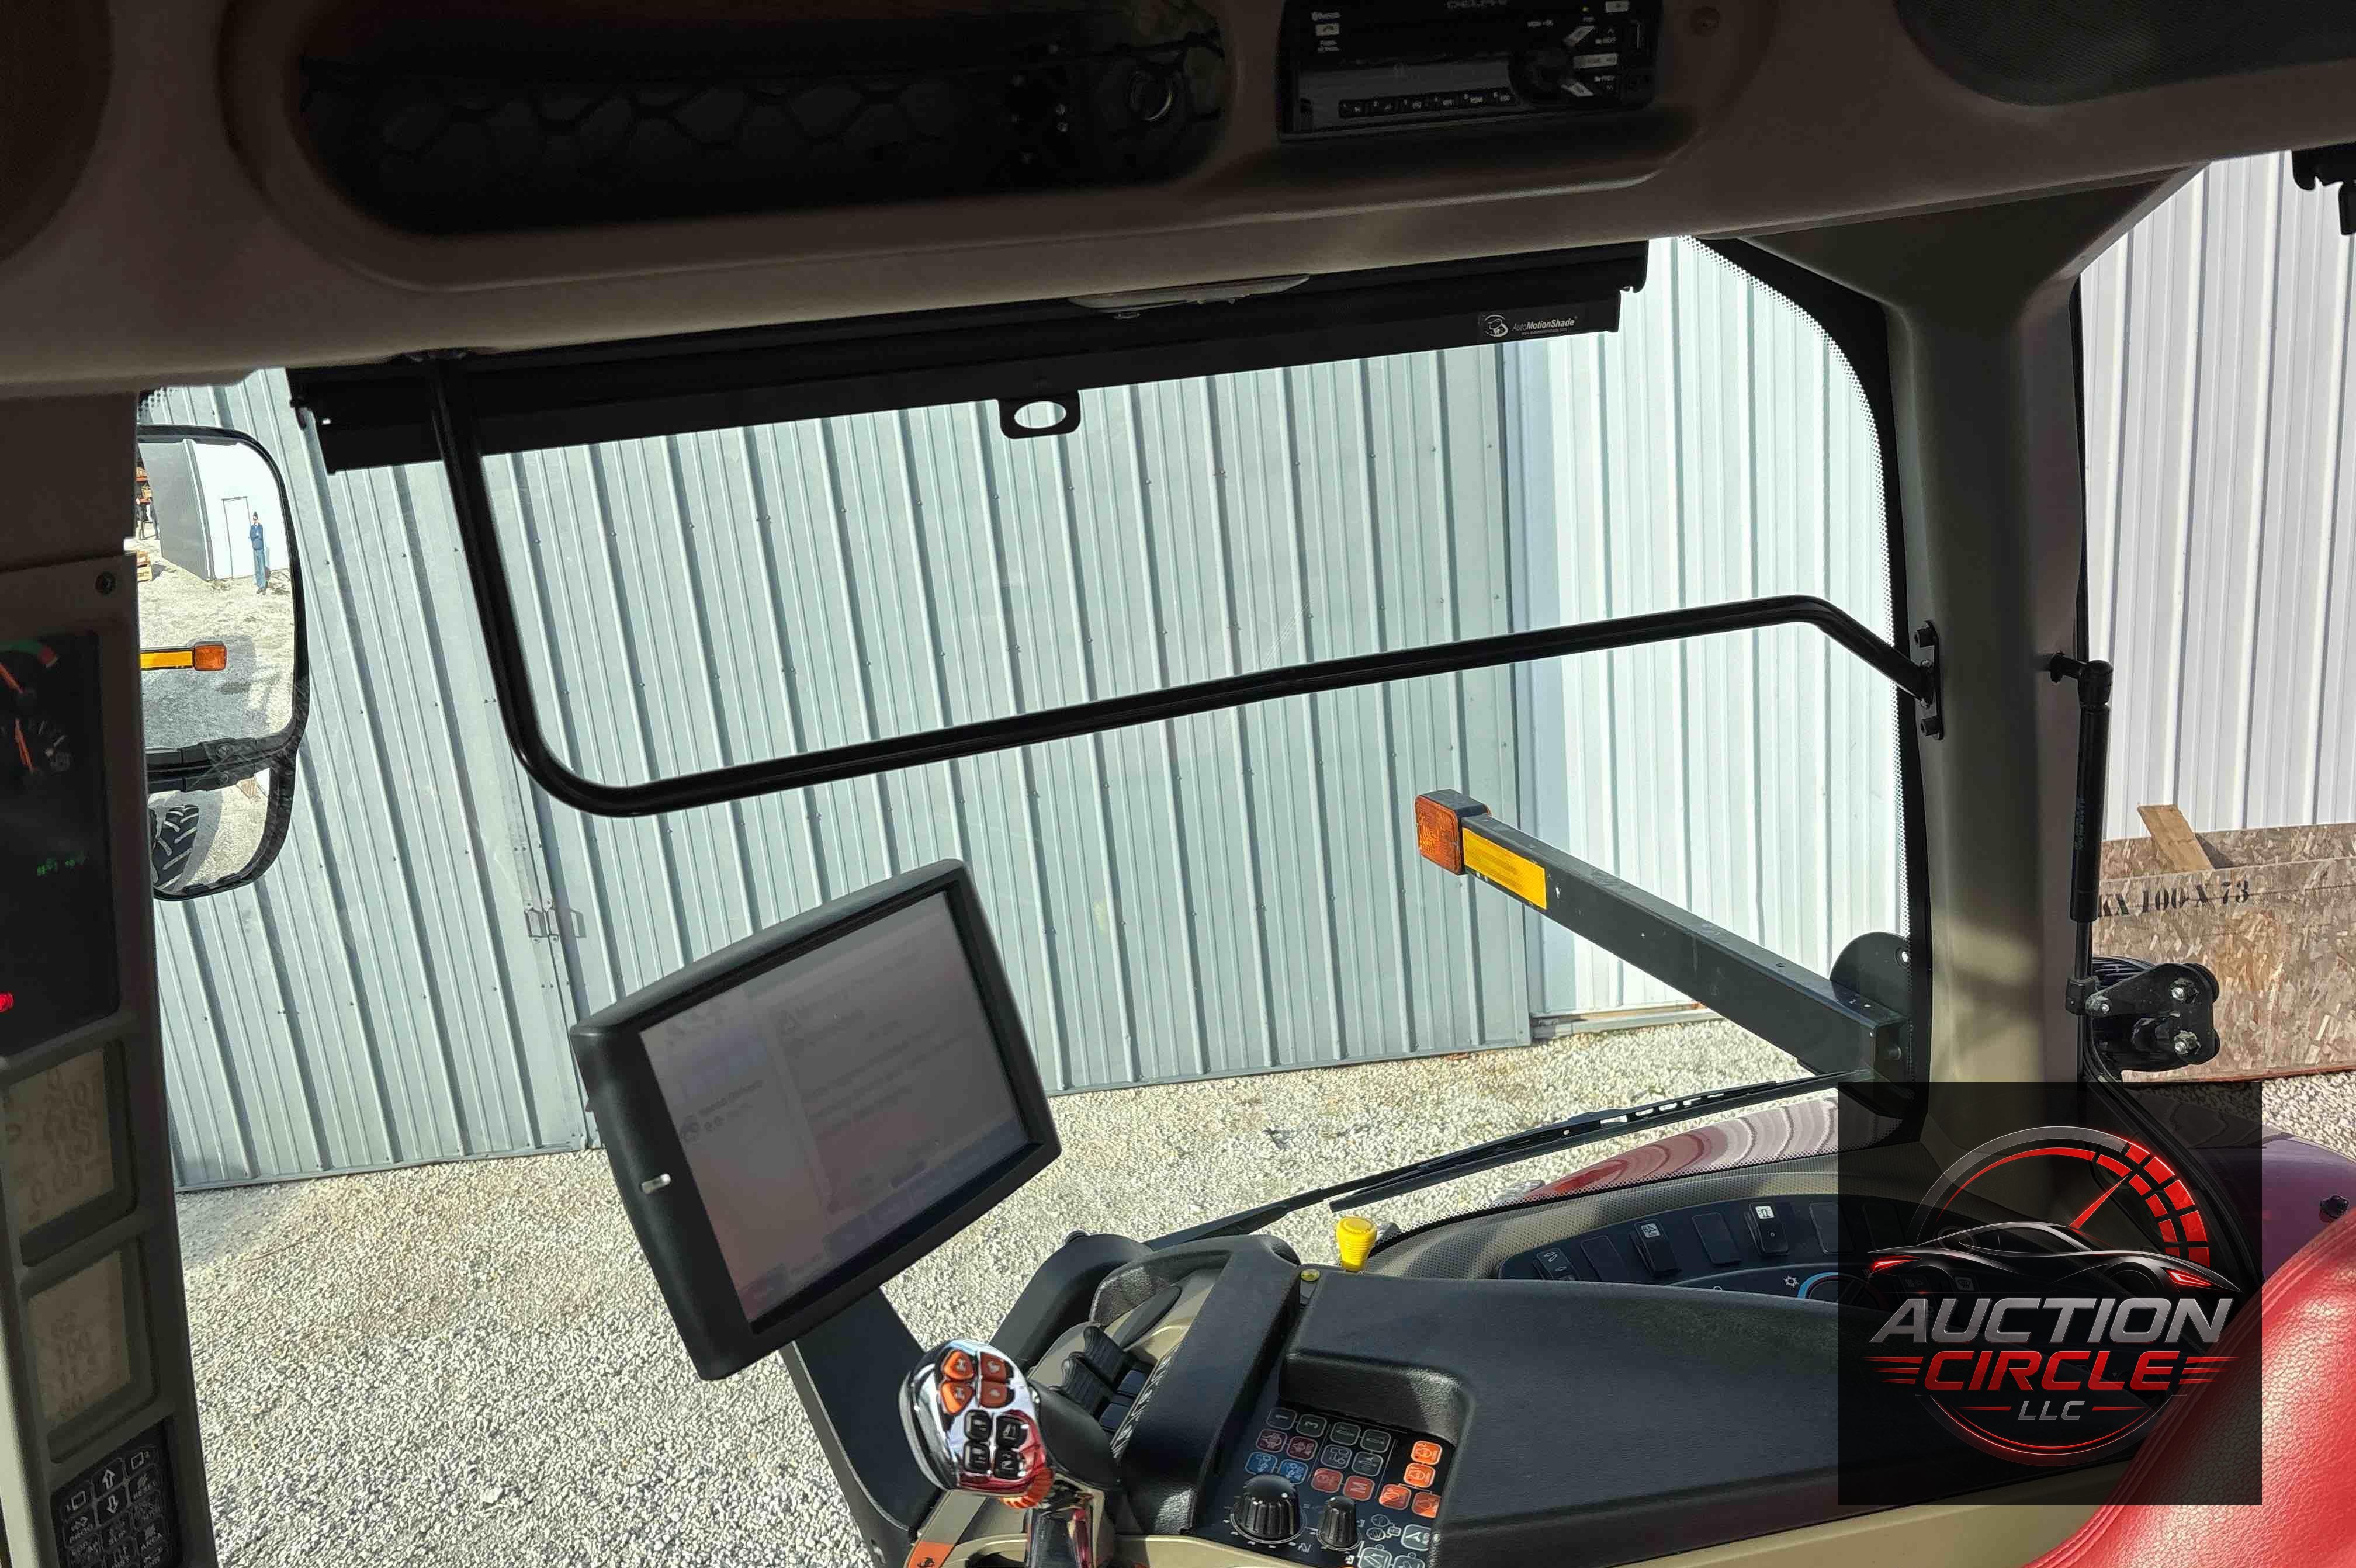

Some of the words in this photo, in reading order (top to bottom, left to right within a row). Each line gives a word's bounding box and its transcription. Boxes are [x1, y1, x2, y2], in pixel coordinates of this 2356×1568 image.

[1512, 317, 1575, 332] AutoMotionShade
[2142, 887, 2187, 913] 100
[2221, 880, 2250, 904] 73
[1304, 1421, 1319, 1429] 3
[1350, 1480, 1368, 1494] M
